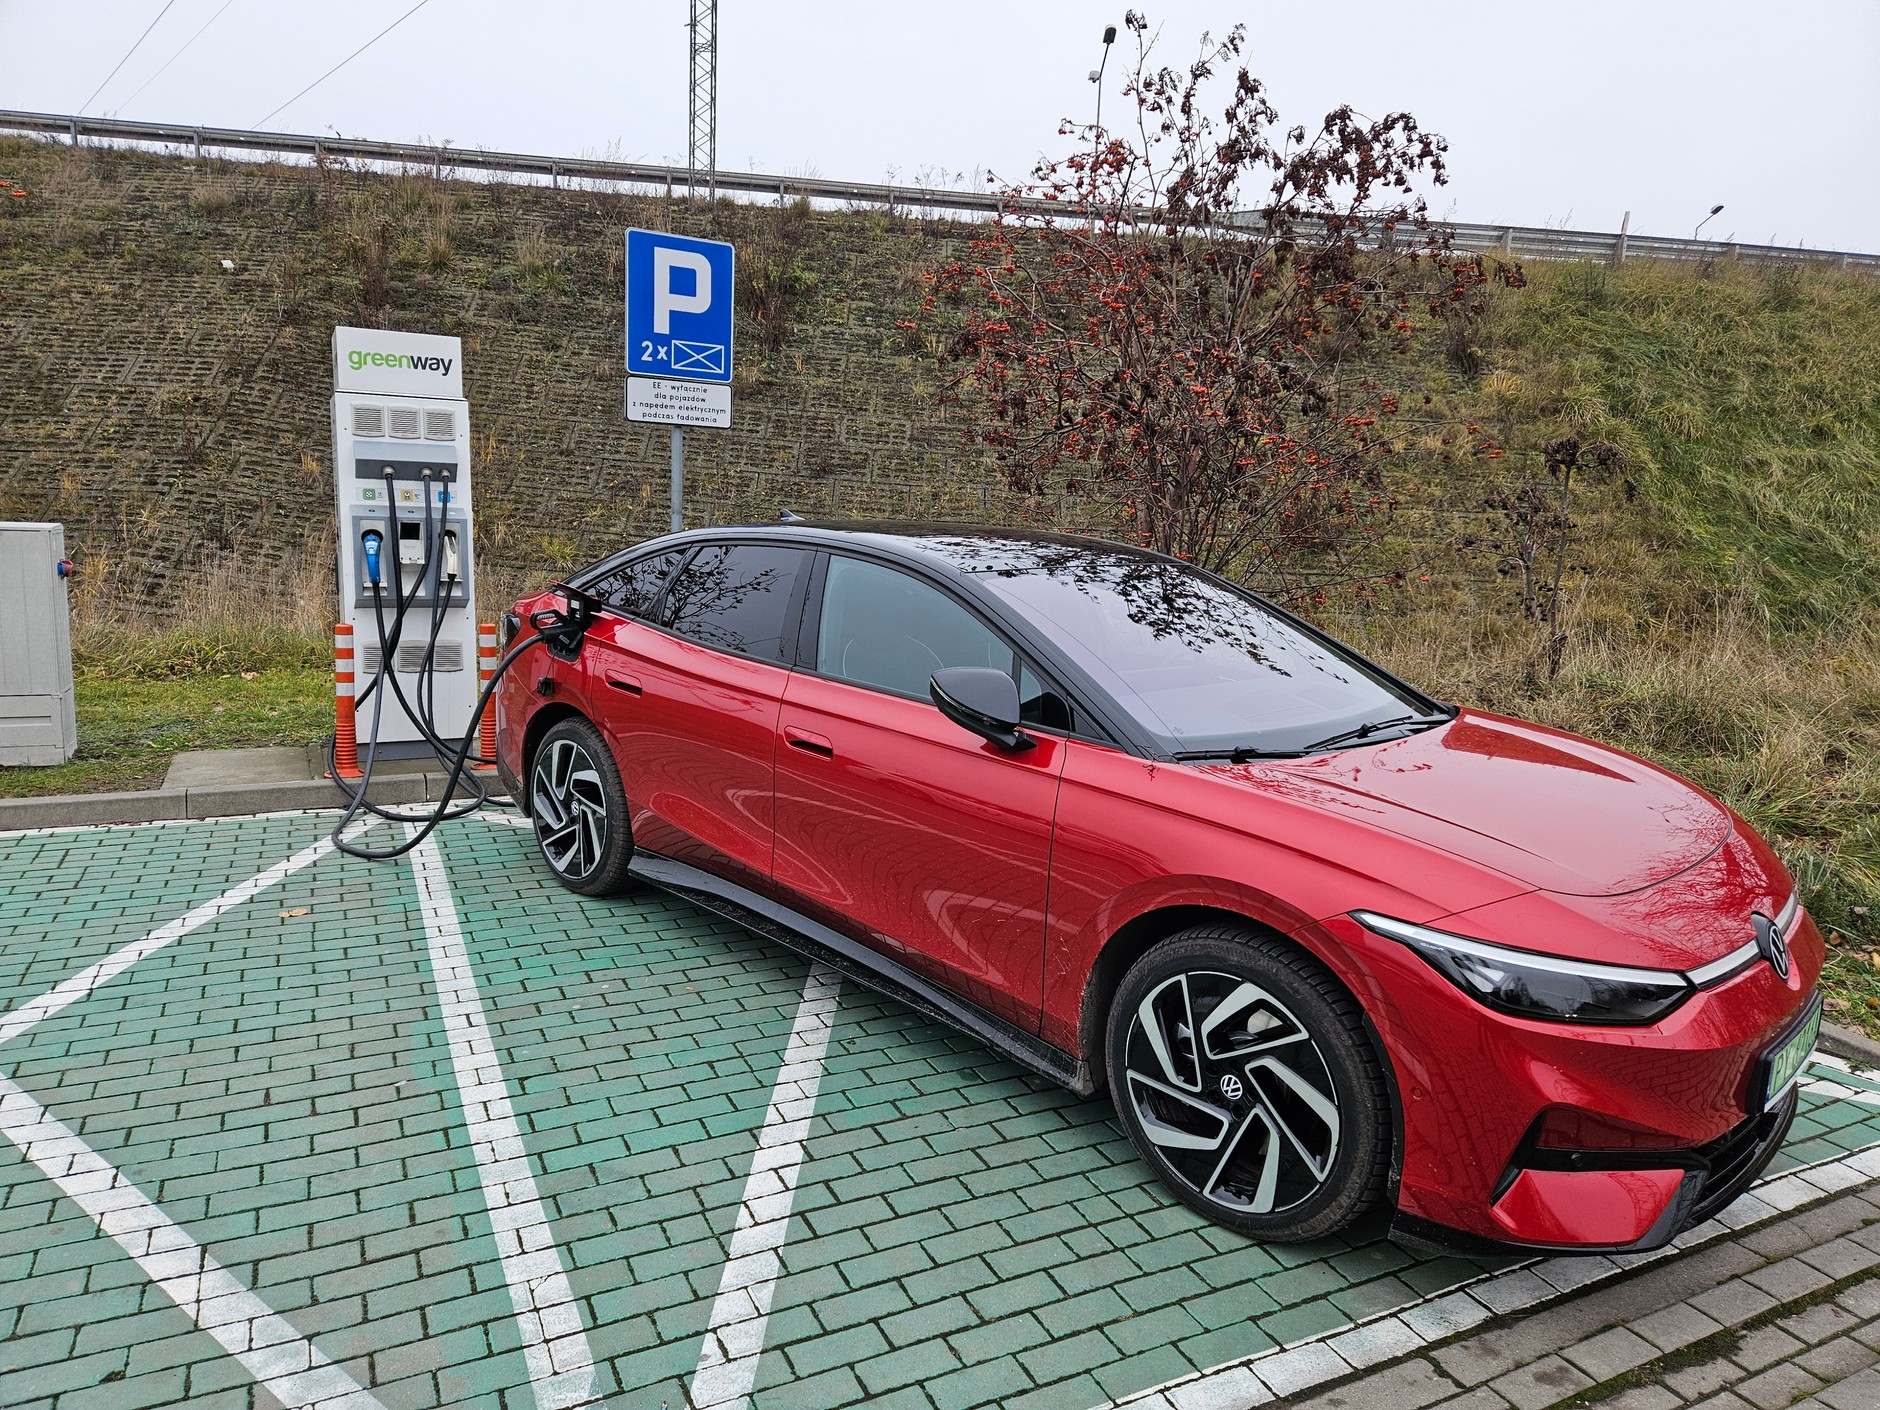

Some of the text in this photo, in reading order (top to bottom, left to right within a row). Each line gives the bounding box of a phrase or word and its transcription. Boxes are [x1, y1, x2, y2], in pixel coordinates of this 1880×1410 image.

[654, 246, 712, 335] P
[641, 340, 668, 362] 2x
[348, 350, 453, 376] greenway
[670, 384, 708, 394] wyłącznie
[669, 394, 707, 403] pojazdów
[639, 402, 676, 411] napędem
[678, 405, 727, 415] elektrycznym
[642, 411, 717, 423] podczas ładowania
